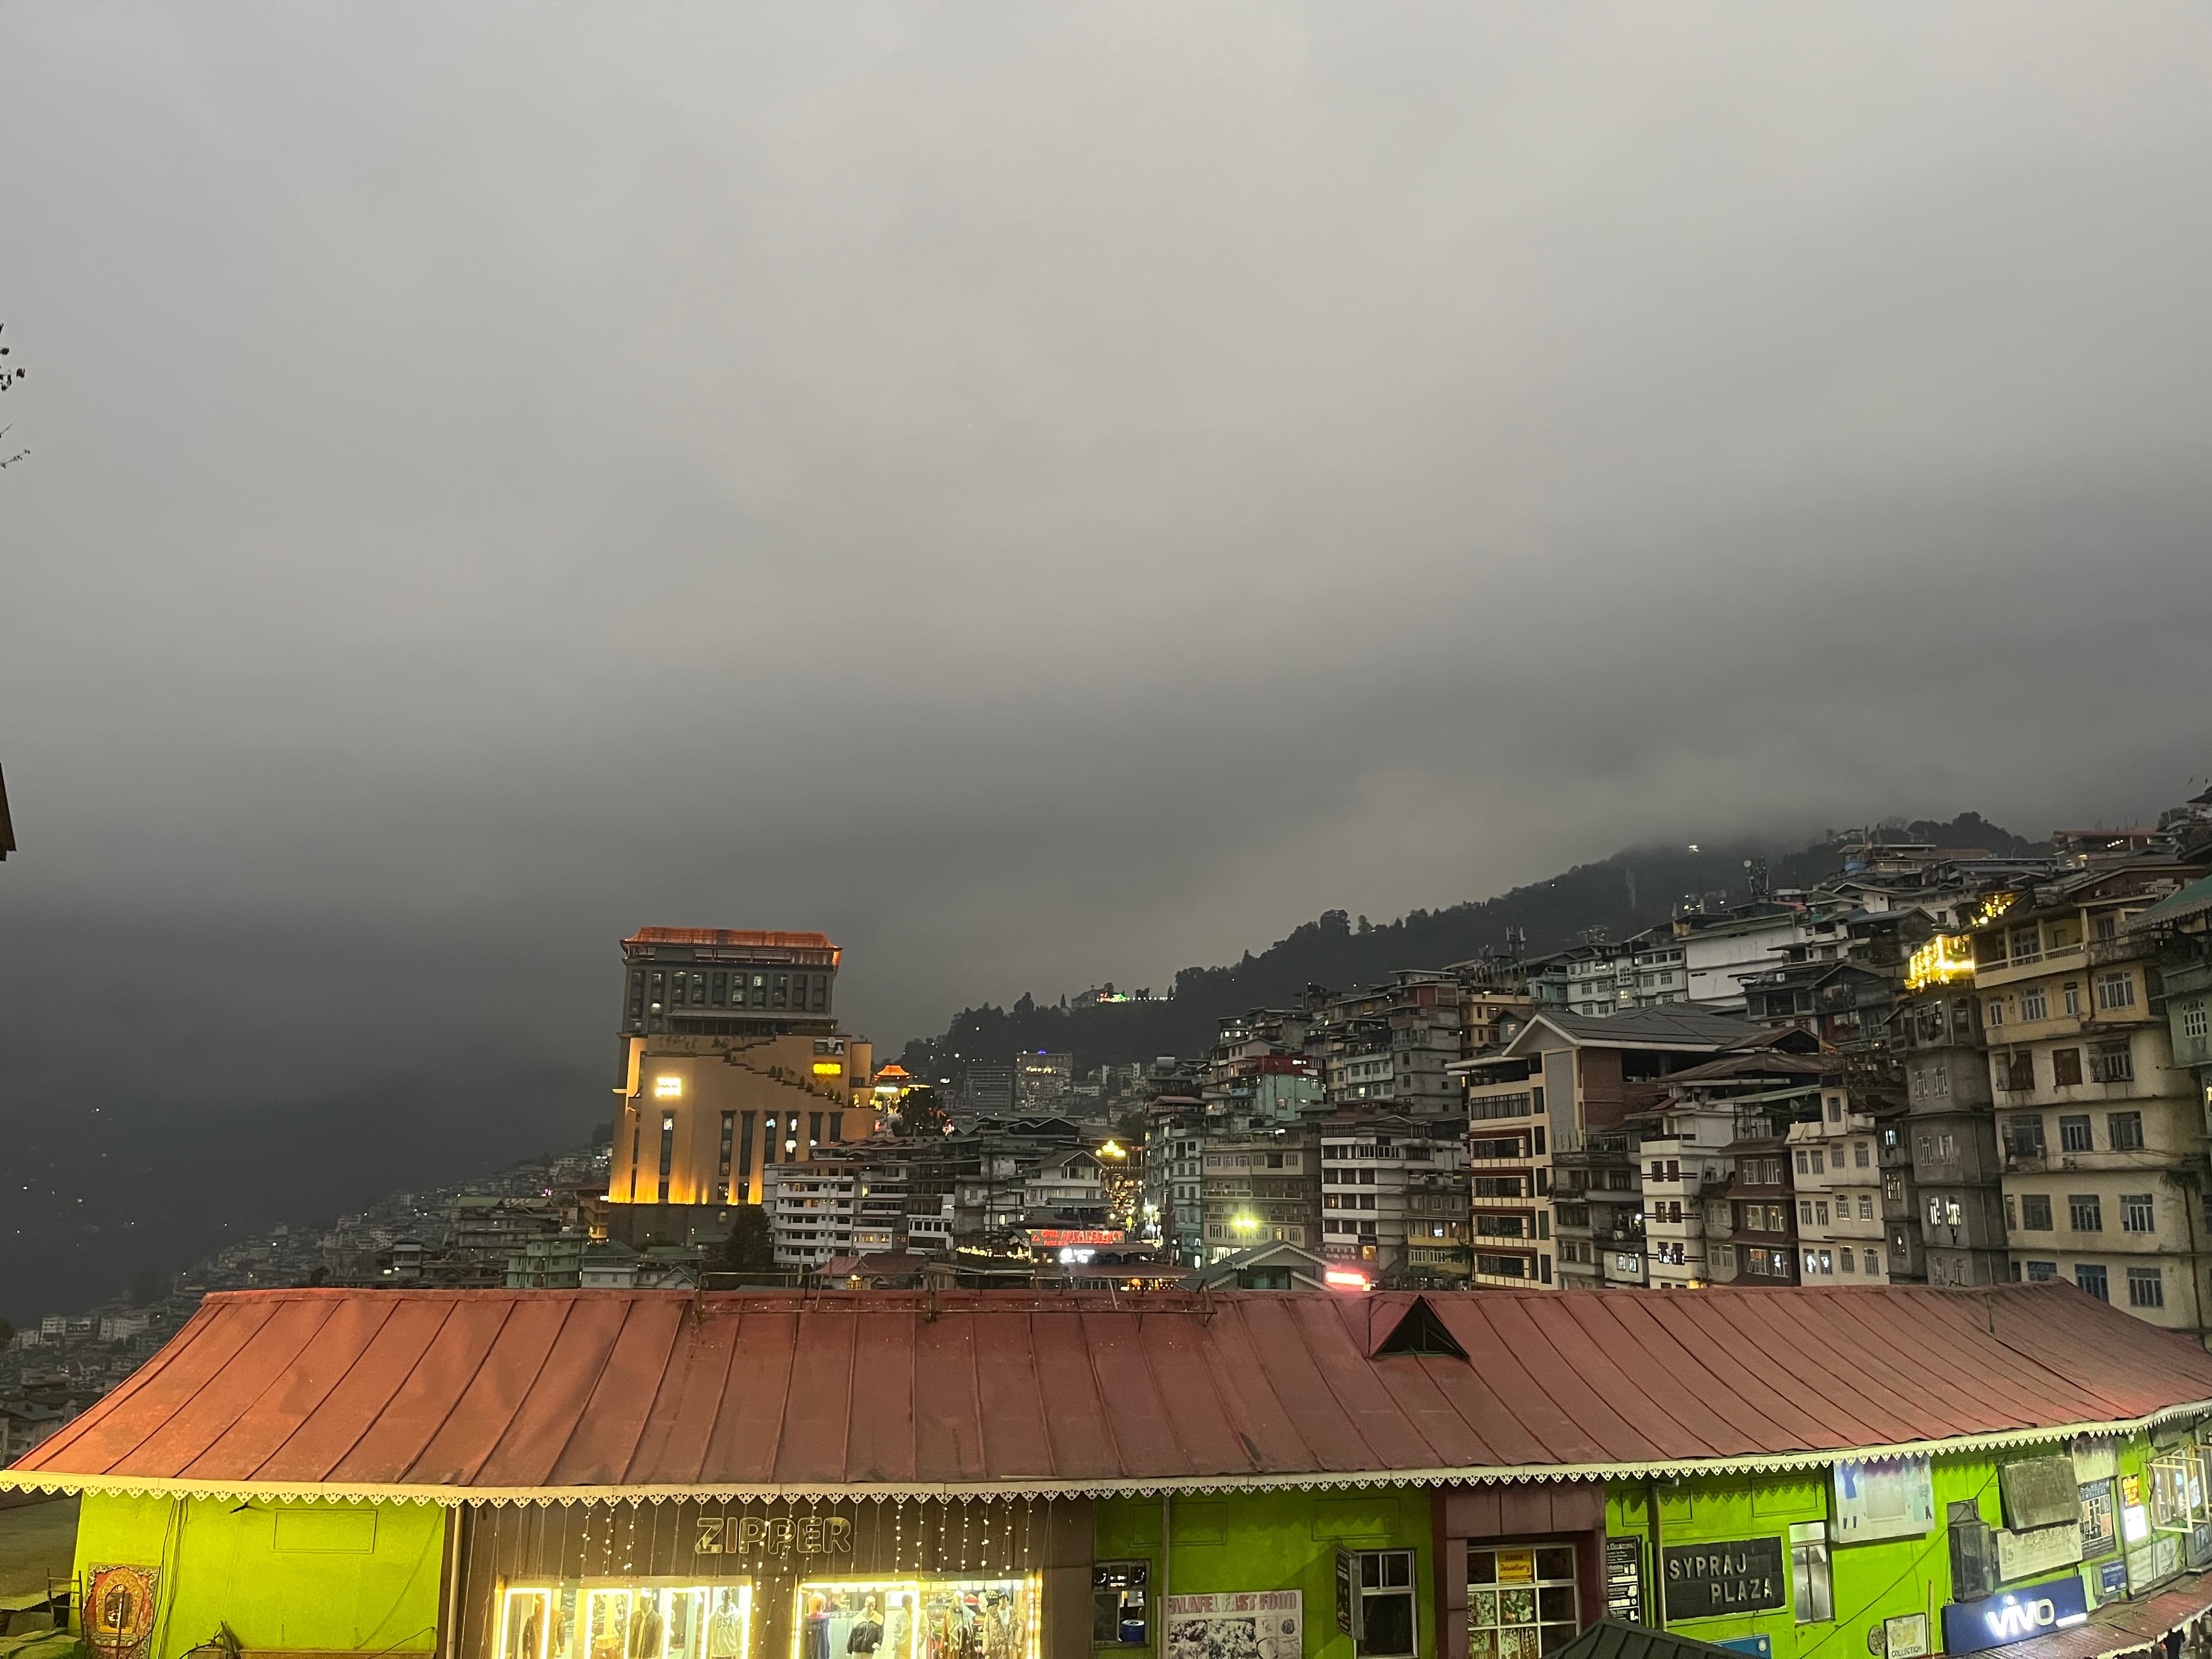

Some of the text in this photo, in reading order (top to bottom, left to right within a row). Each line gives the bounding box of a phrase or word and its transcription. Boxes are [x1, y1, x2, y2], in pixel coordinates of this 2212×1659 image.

[695, 1517, 851, 1554] ZIPPER
[1669, 1553, 1747, 1580] SYPRAJ
[1222, 1594, 1257, 1612] FAST
[1259, 1592, 1297, 1610] FOOD
[1710, 1578, 1772, 1604] PLAZA
[717, 1618, 733, 1628] USA
[1891, 1646, 1922, 1657] COLLECTION
